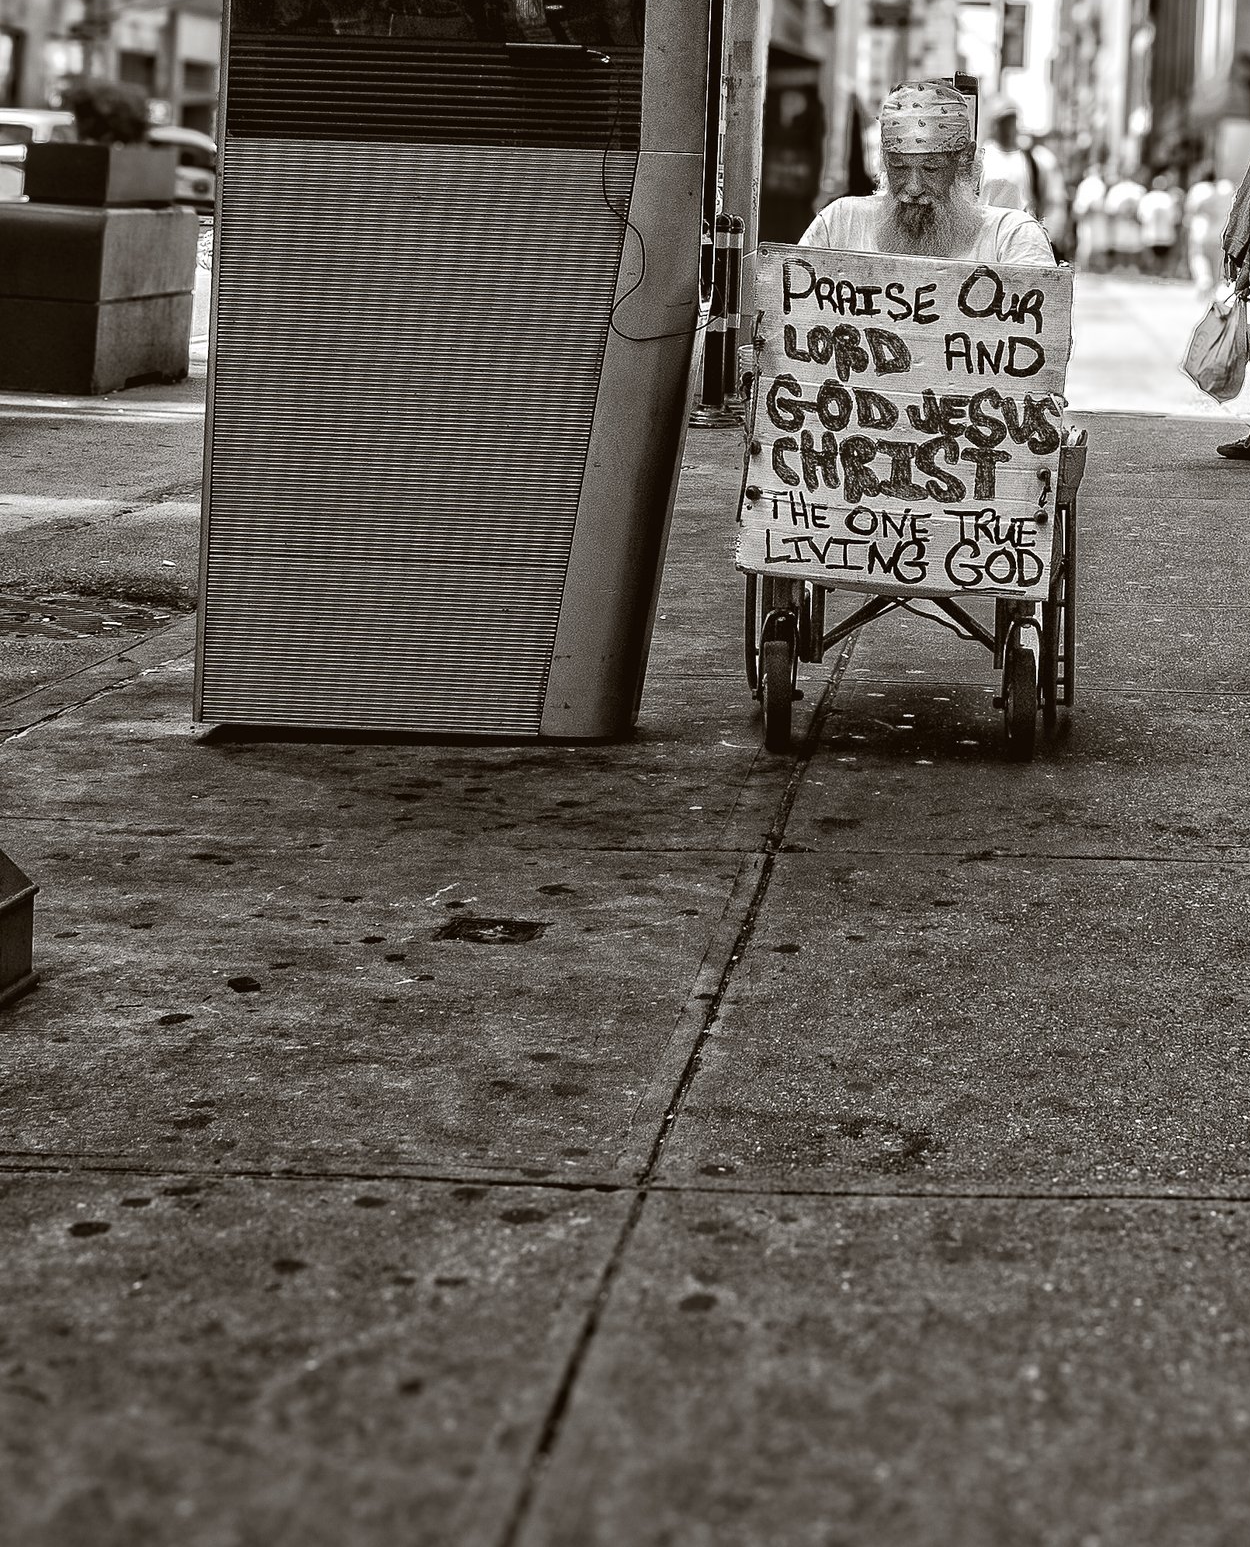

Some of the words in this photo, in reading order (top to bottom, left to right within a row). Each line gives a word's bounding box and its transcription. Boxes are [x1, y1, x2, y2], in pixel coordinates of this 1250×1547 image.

[783, 258, 940, 324] PRAISE
[957, 265, 1045, 334] OUR
[784, 323, 912, 382] LORD
[944, 332, 1046, 378] AND
[766, 373, 899, 433] GOD
[905, 387, 1067, 455] JESUS
[772, 429, 1012, 503] CHRIST
[771, 490, 830, 529] THE
[845, 506, 932, 543] ONE
[944, 507, 1038, 548] TRUE
[764, 529, 930, 584] LIVING
[944, 538, 1044, 587] GOD
